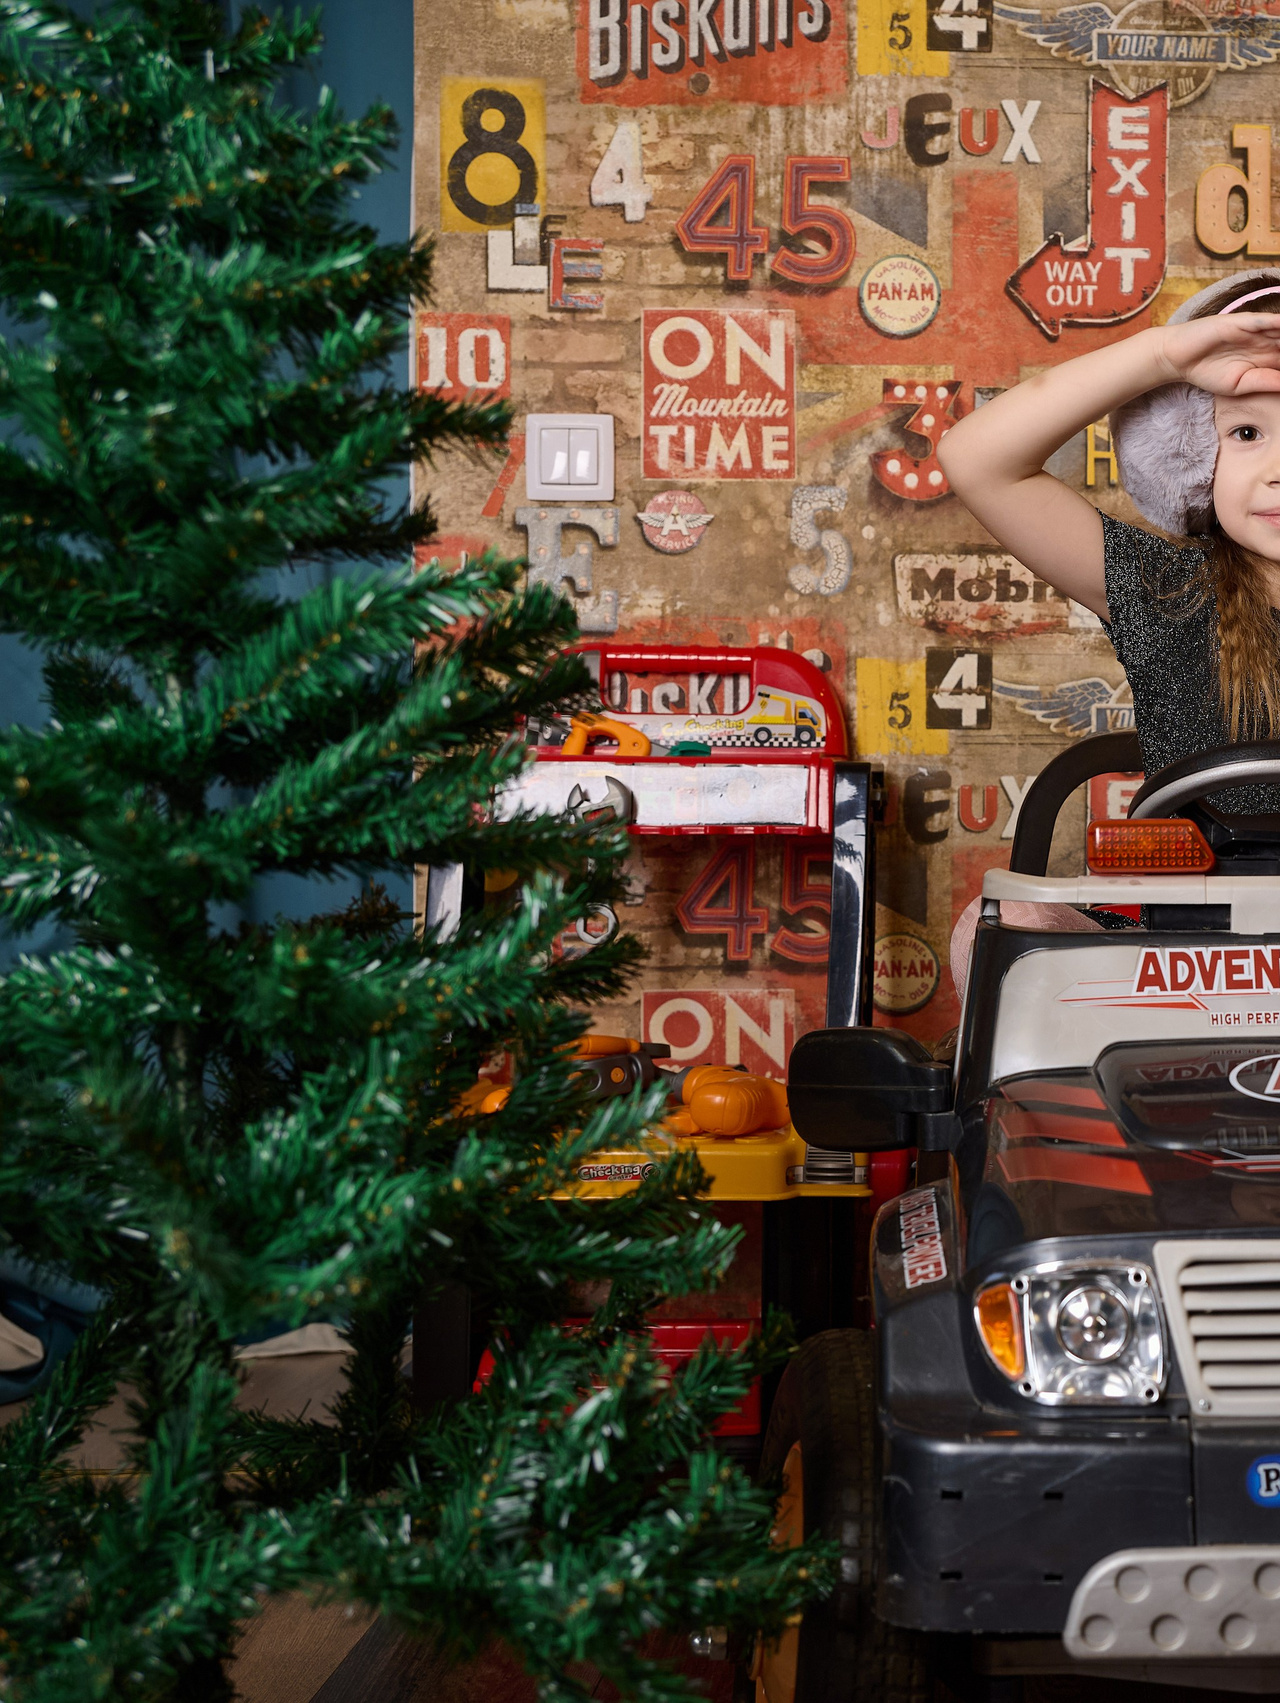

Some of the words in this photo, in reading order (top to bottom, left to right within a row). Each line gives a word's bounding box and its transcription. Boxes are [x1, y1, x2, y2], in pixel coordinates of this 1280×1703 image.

[888, 14, 912, 50] 5
[934, 0, 988, 50] 4
[1107, 34, 1158, 58] YOUR
[1161, 36, 1219, 59] NAME
[447, 88, 537, 225] 8
[590, 122, 653, 222] 4
[676, 154, 857, 284] 45
[1106, 106, 1151, 294] EXIT
[875, 261, 926, 278] GASOLINE
[1045, 262, 1102, 282] WAY
[867, 282, 935, 301] PAN-AM
[1046, 286, 1098, 306] OUT
[421, 327, 506, 388] 10
[649, 315, 786, 390] ON
[651, 383, 789, 418] Mountain
[649, 421, 790, 471] TIME
[872, 378, 962, 499] 3
[653, 534, 697, 549] SERVICE
[789, 487, 852, 595] 5
[911, 568, 1068, 603] Mobi
[931, 654, 986, 726] 4
[685, 717, 745, 732] Checking
[888, 693, 911, 731] 5
[649, 997, 786, 1070] ON
[1210, 1012, 1241, 1026] HIGH
[580, 1165, 640, 1180] Checking
